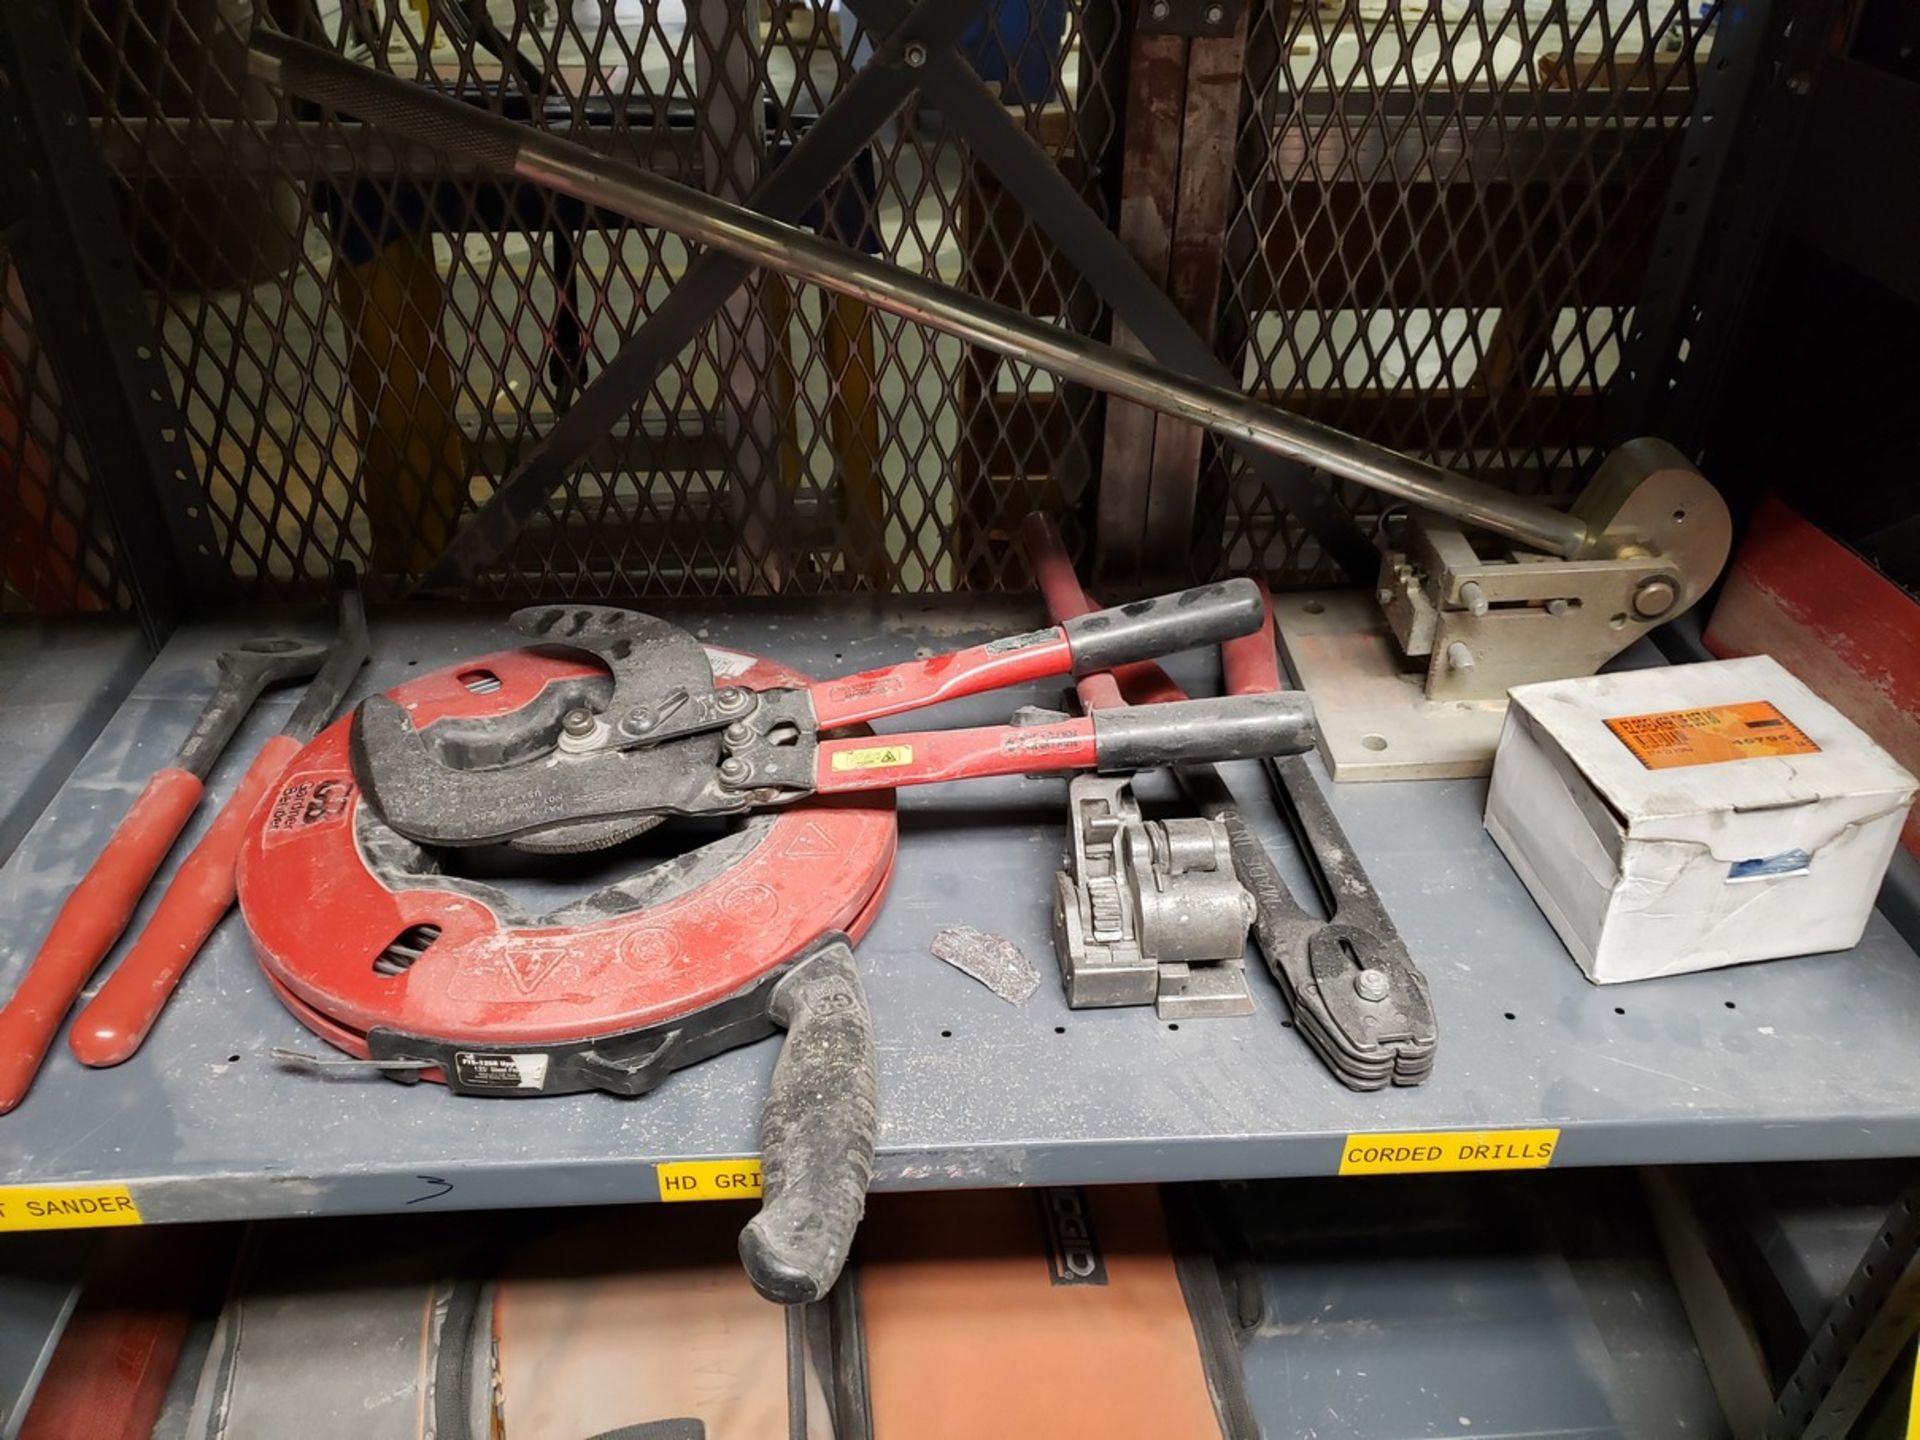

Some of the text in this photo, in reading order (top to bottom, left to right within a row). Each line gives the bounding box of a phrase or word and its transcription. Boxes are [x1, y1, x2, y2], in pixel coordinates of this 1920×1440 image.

[1348, 1142, 1552, 1163] CORDED DRILLS
[665, 1172, 762, 1191] HD GRI
[25, 1196, 135, 1217] SANDER
